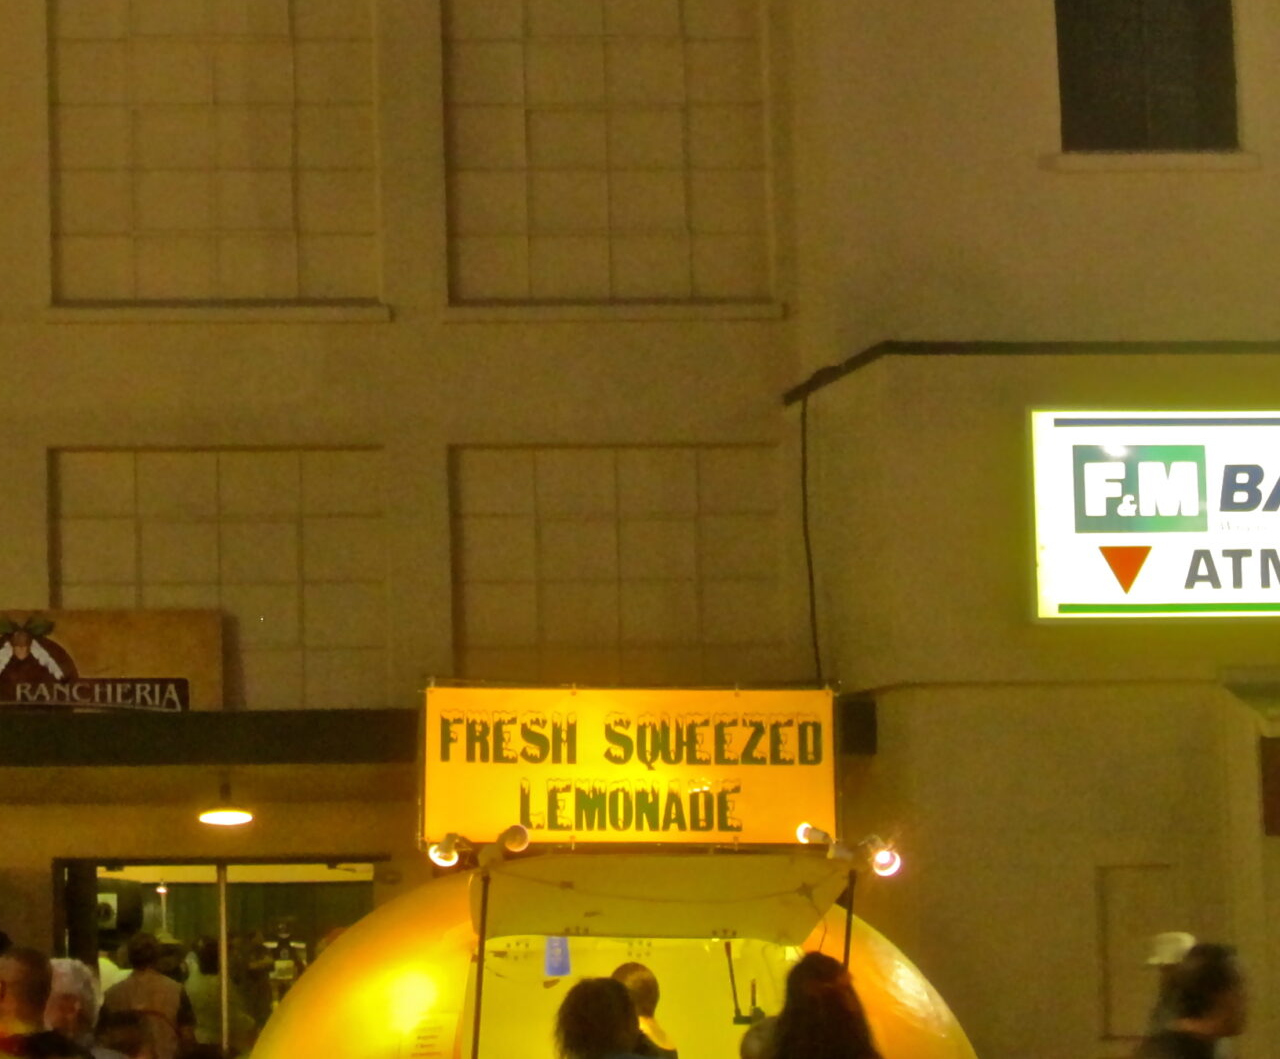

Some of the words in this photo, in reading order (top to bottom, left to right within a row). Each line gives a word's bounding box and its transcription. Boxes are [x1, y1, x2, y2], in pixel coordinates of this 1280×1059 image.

[1084, 461, 1200, 517] F&M
[16, 682, 182, 713] RANCHERIA
[439, 709, 577, 764] FRESH
[603, 710, 823, 770] SQUEEZED
[519, 777, 743, 833] LEMONADE
